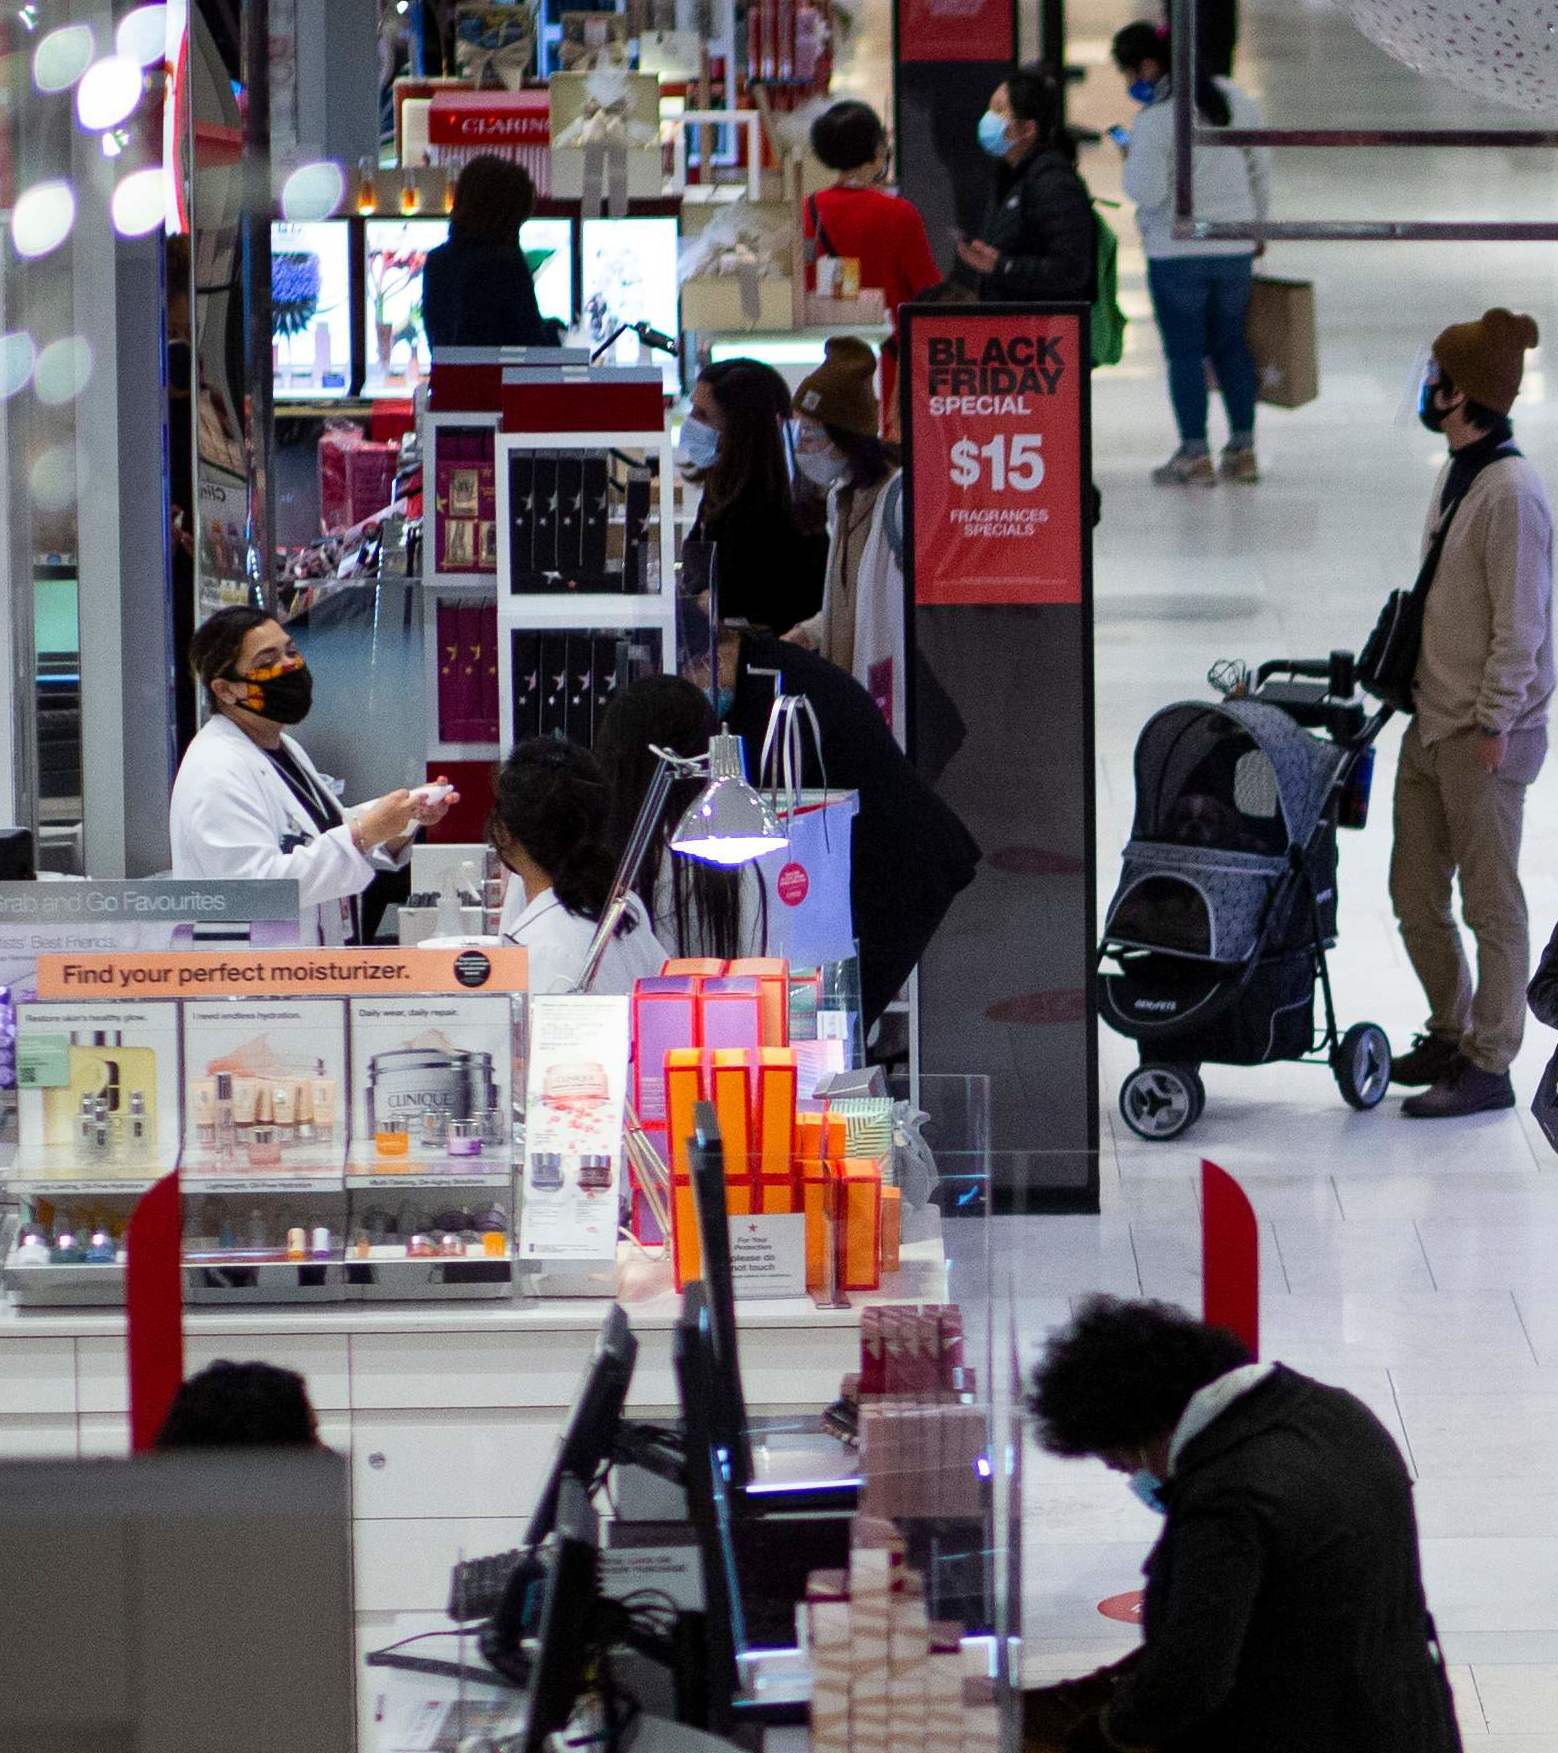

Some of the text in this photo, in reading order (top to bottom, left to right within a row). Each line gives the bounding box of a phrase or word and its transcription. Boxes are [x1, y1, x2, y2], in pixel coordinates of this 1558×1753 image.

[927, 335, 1065, 367] BLACK
[927, 366, 1066, 396] FRIDAY
[929, 395, 1032, 416] SPECIAL
[949, 432, 1046, 493] $15
[949, 508, 1050, 524] FRAGRANCES
[964, 523, 1036, 538] SPECIALS
[0, 891, 226, 912] rab and Go Favourites
[62, 961, 411, 987] Find your perfect moisturizer.
[387, 1092, 457, 1109] CLINIQUE
[749, 1262, 776, 1272] touch
[763, 1252, 776, 1263] do
